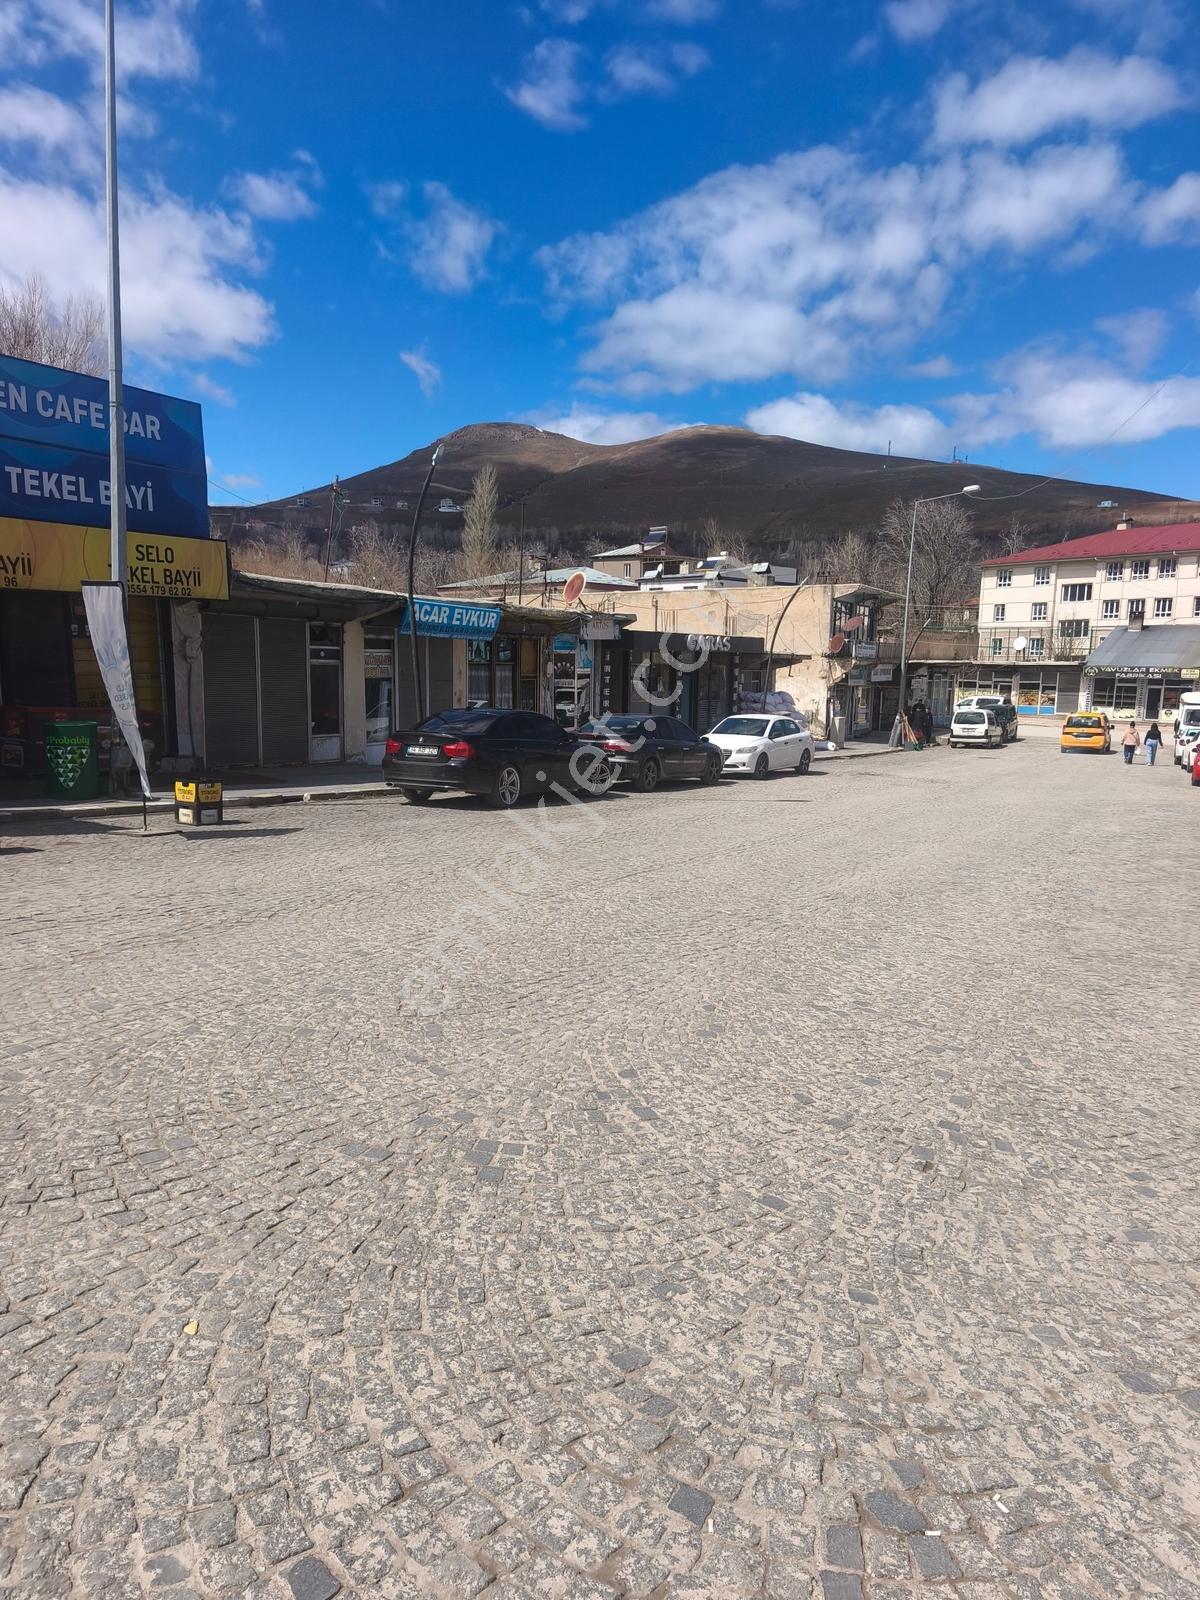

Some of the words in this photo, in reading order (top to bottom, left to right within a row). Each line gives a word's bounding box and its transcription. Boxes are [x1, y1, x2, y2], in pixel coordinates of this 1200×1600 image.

[36, 389, 105, 429] CAFE
[5, 466, 93, 503] TEKEL
[135, 544, 174, 564] SELO
[4, 576, 18, 587] 96
[108, 564, 159, 584] KEL
[149, 586, 166, 596] 179
[168, 587, 179, 597] 62
[181, 588, 192, 597] 02
[413, 602, 450, 624] ACAR
[451, 608, 497, 629] EVKUR
